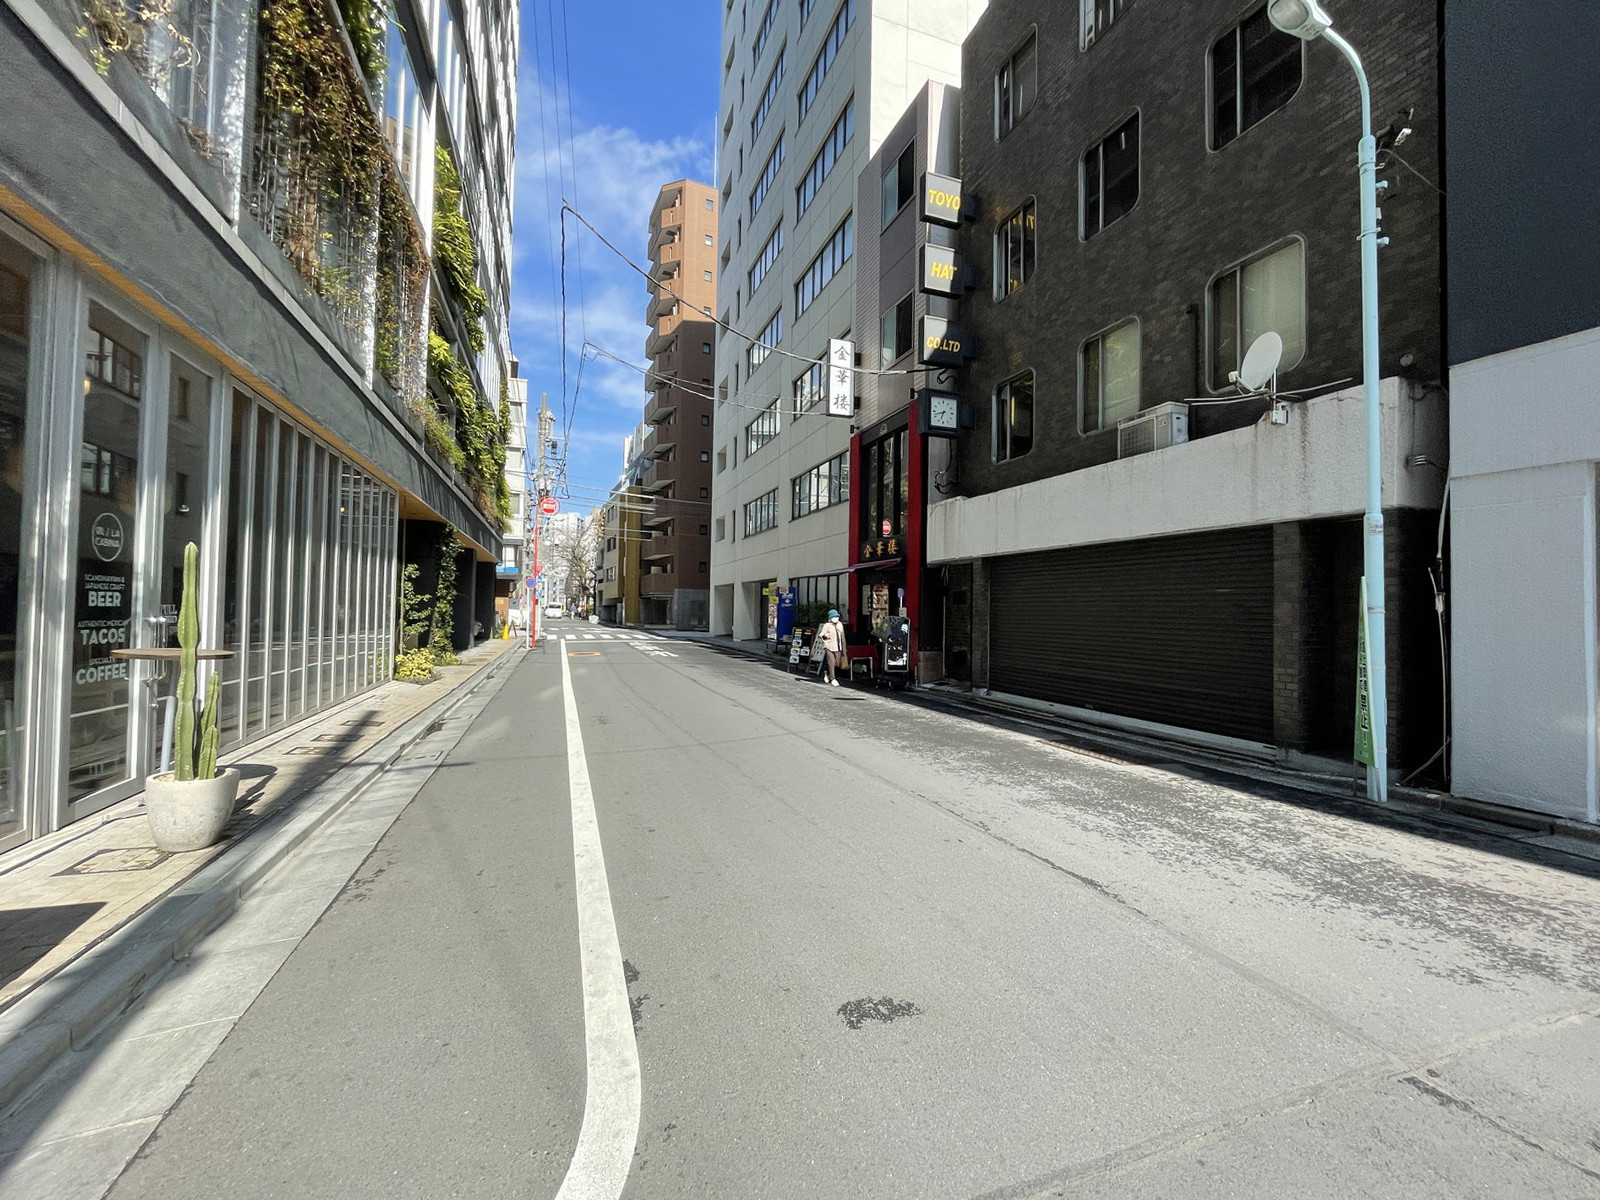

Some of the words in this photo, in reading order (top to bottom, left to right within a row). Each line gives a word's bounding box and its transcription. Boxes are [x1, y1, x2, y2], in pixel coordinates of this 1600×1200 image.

[928, 188, 961, 211] TOYO
[931, 262, 957, 281] HAT
[926, 336, 961, 353] CO.LTD
[88, 590, 121, 607] BEER
[80, 628, 126, 645] TACOS
[76, 663, 127, 685] COFFEE
